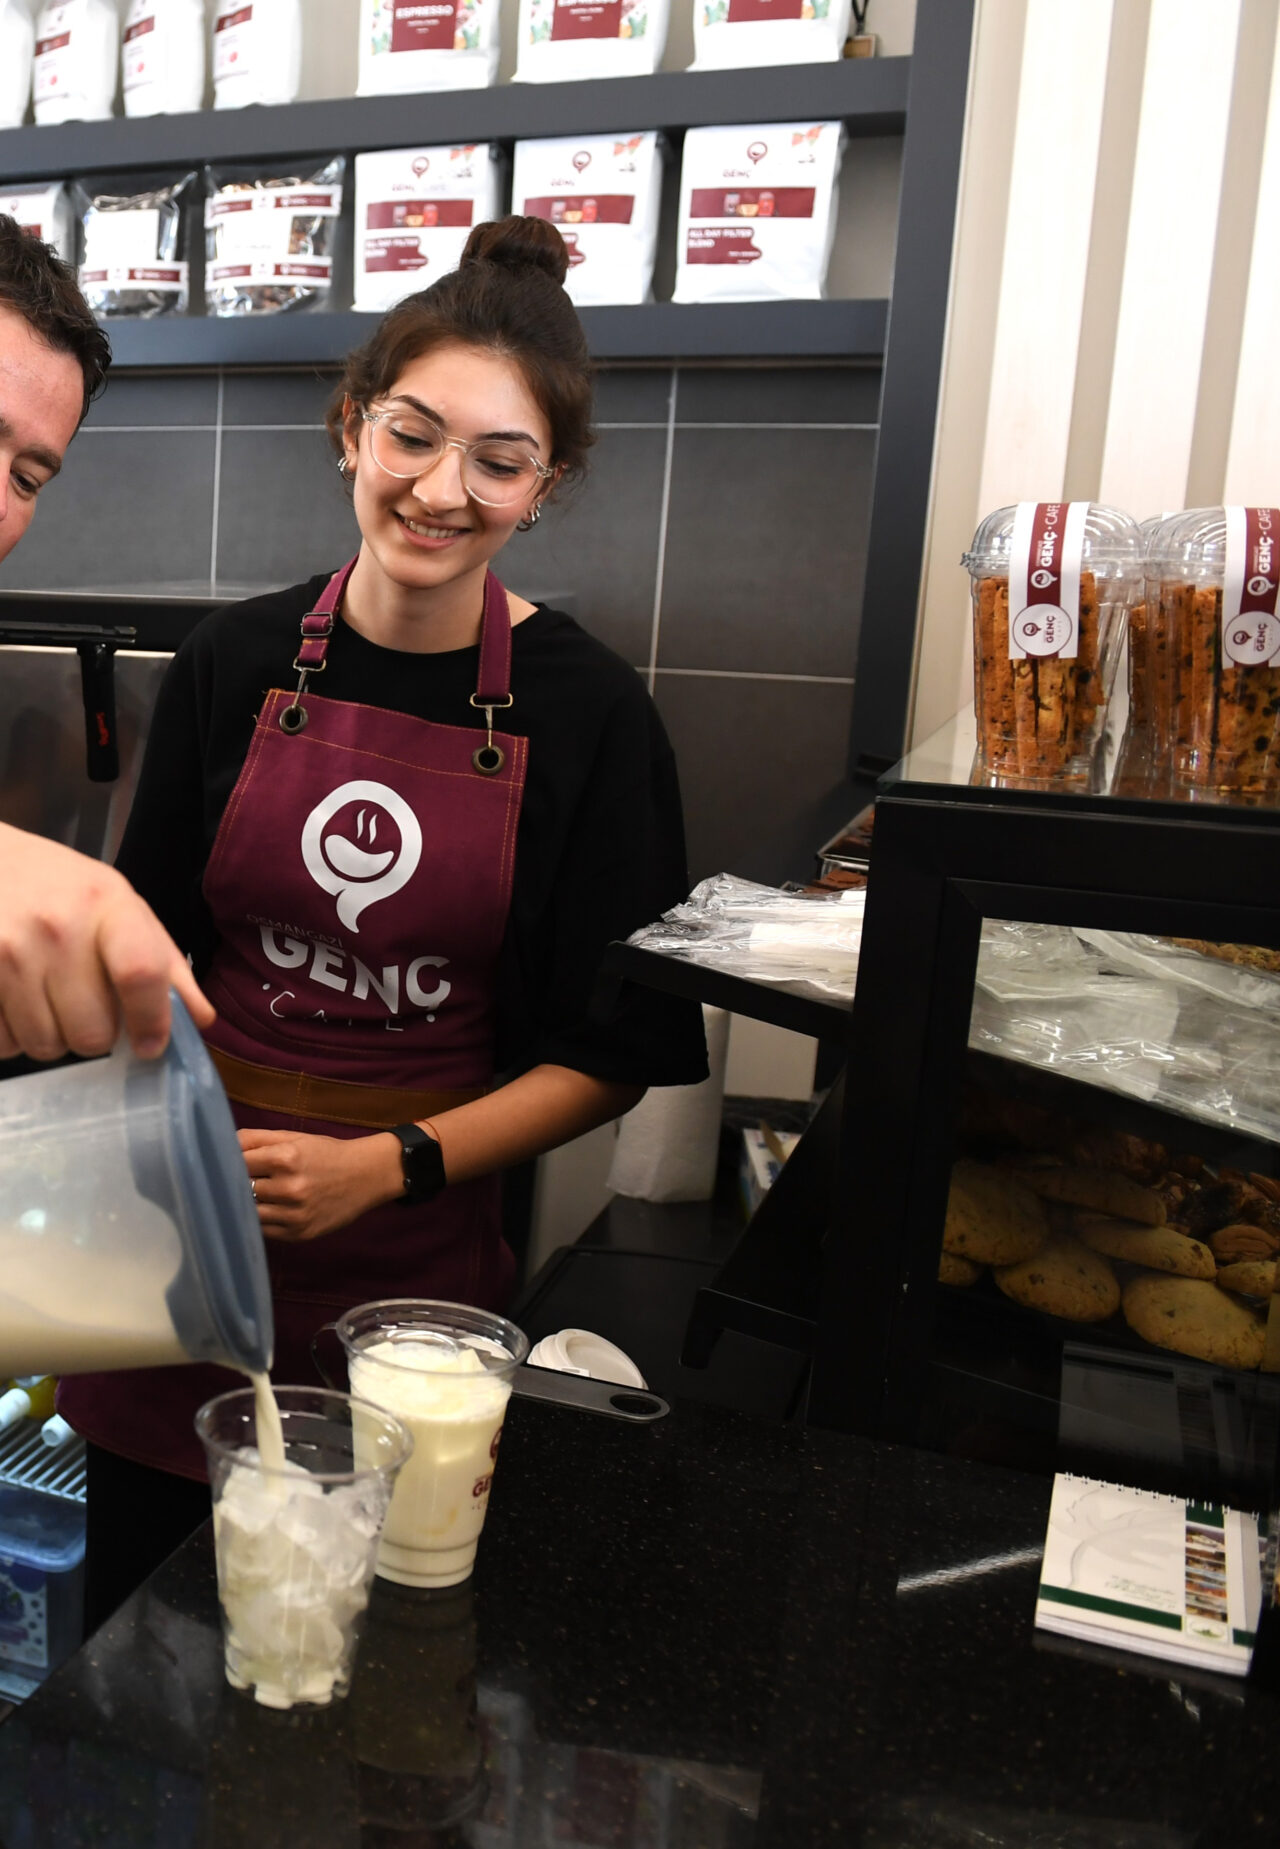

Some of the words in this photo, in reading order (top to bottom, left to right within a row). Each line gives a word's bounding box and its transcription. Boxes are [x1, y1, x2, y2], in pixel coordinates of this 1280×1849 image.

[1040, 531, 1058, 567] GENÇ
[1258, 536, 1274, 574] GENÇ
[1046, 615, 1056, 643] GENÇ
